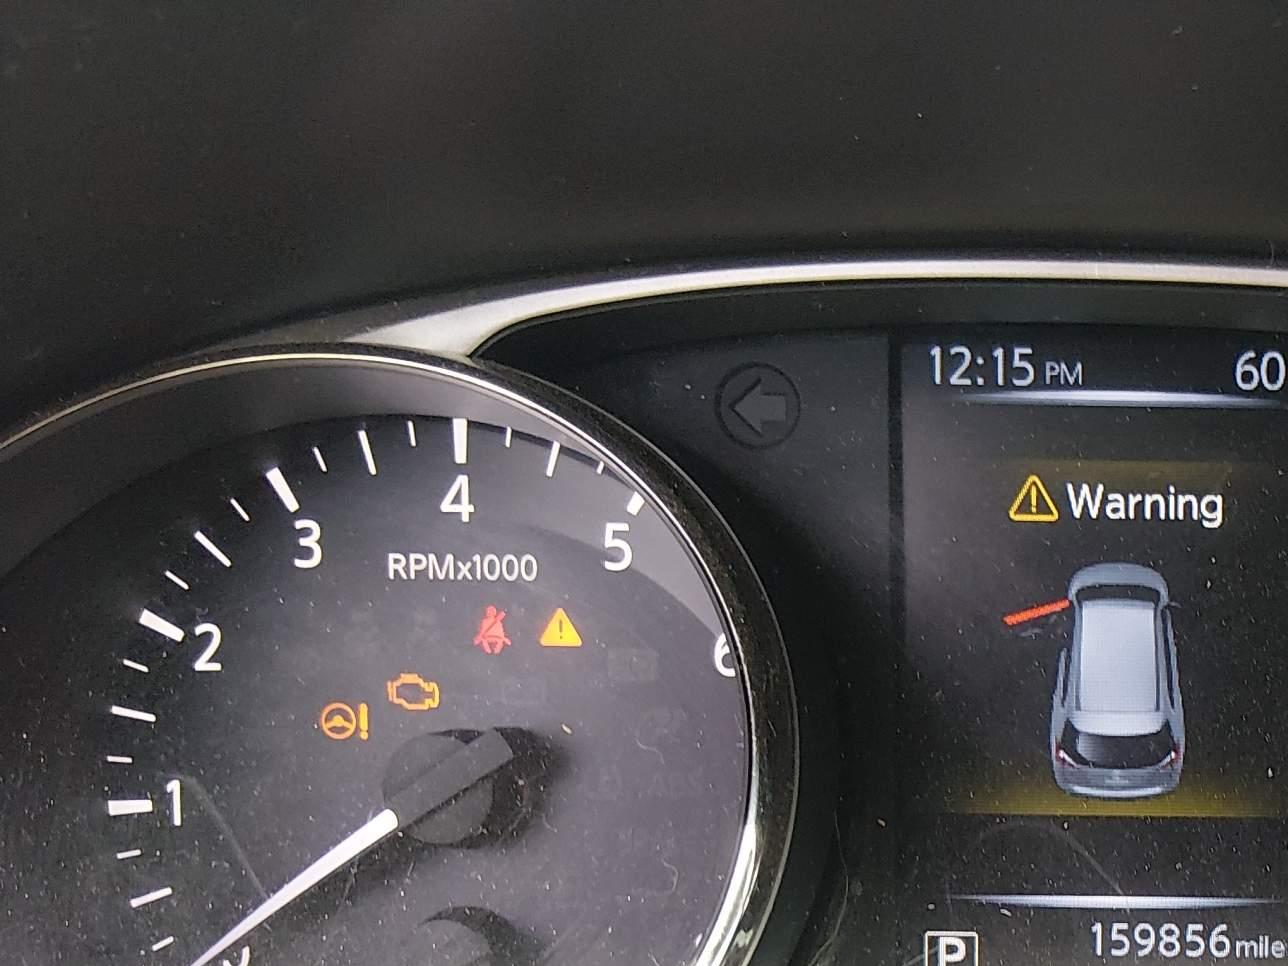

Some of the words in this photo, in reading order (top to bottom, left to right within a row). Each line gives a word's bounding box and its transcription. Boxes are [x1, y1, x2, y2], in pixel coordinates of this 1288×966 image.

[929, 346, 1034, 385] 12:15
[1045, 361, 1083, 386] PM
[440, 475, 475, 522] 4
[1066, 482, 1223, 529] Warning
[294, 519, 322, 568] 3
[604, 522, 633, 571] 5
[387, 553, 538, 582] RPMx1000
[194, 622, 222, 672] 2
[166, 780, 182, 826] 1
[1091, 922, 1231, 958] 159856
